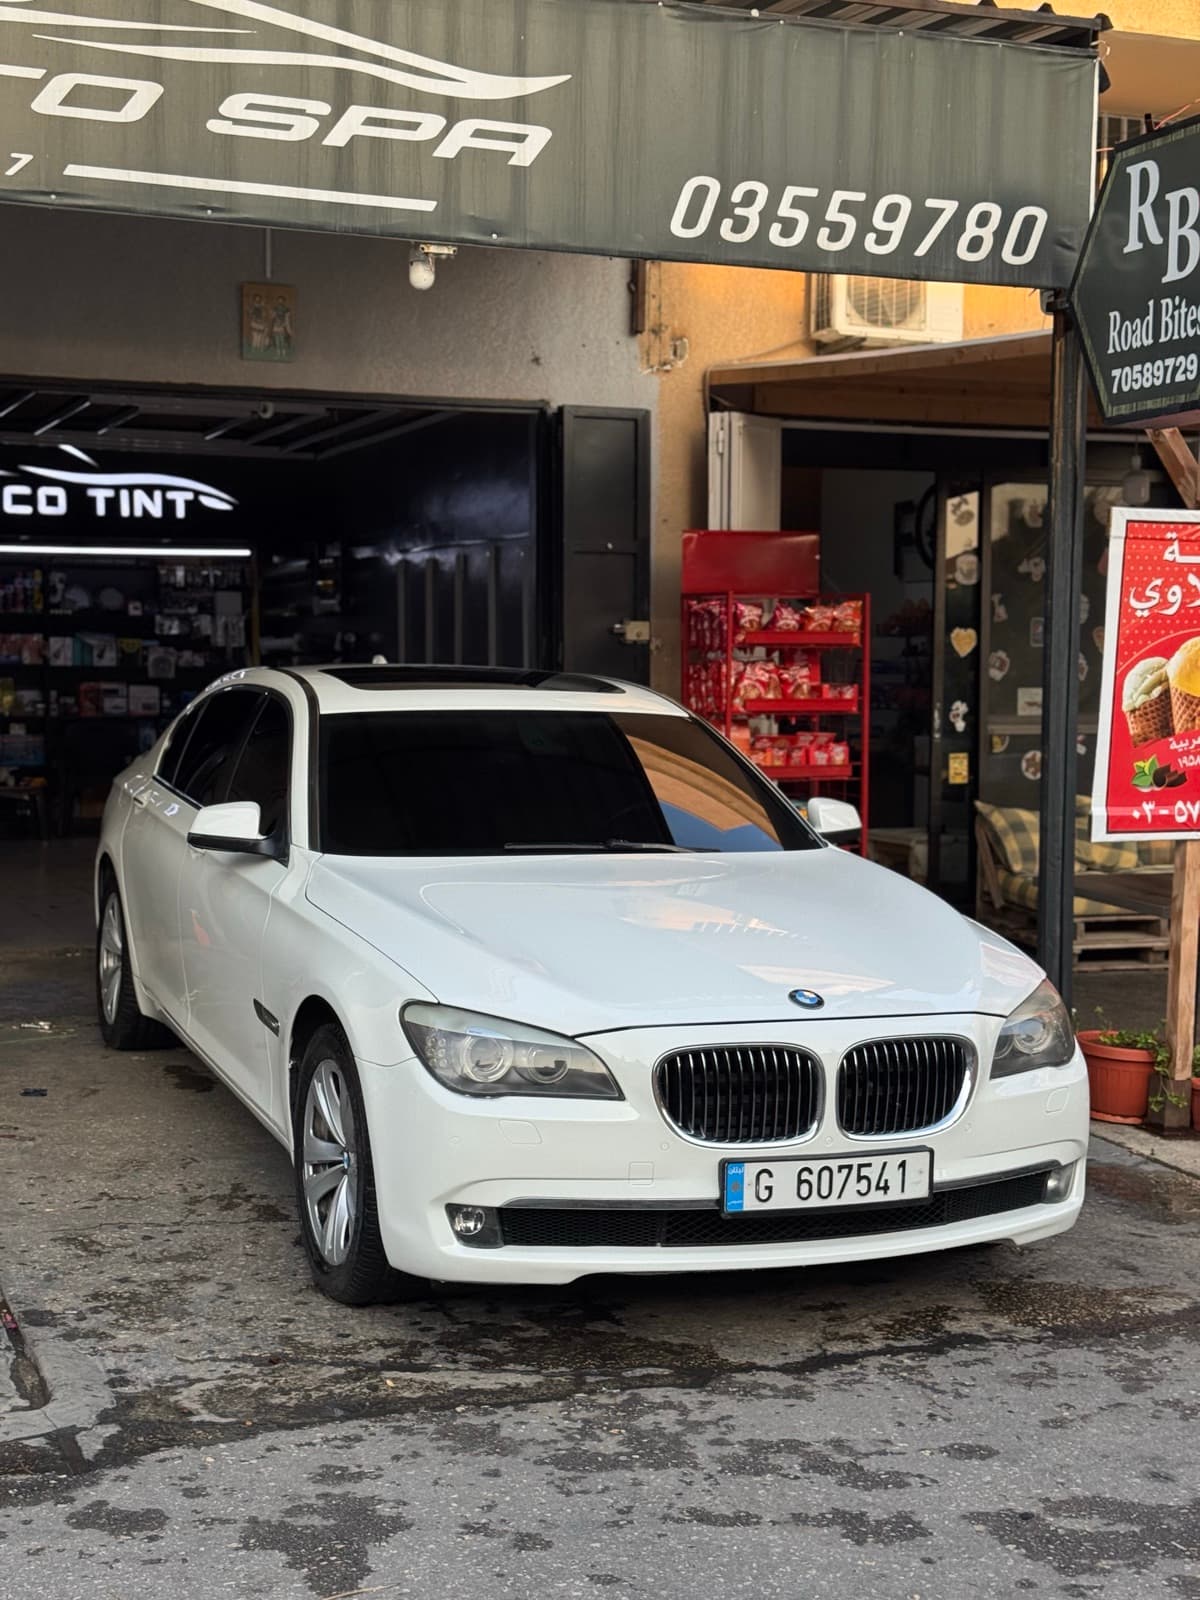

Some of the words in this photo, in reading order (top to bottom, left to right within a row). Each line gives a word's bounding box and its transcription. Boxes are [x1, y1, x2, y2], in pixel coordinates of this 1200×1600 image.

[206, 92, 553, 167] SPA
[670, 175, 1048, 265] 03559780
[1107, 299, 1154, 354] Road
[1111, 353, 1199, 394] 70589729
[2, 485, 68, 516] CO
[86, 487, 195, 519] TINT
[754, 1168, 774, 1203] G
[796, 1159, 908, 1201] 607541
